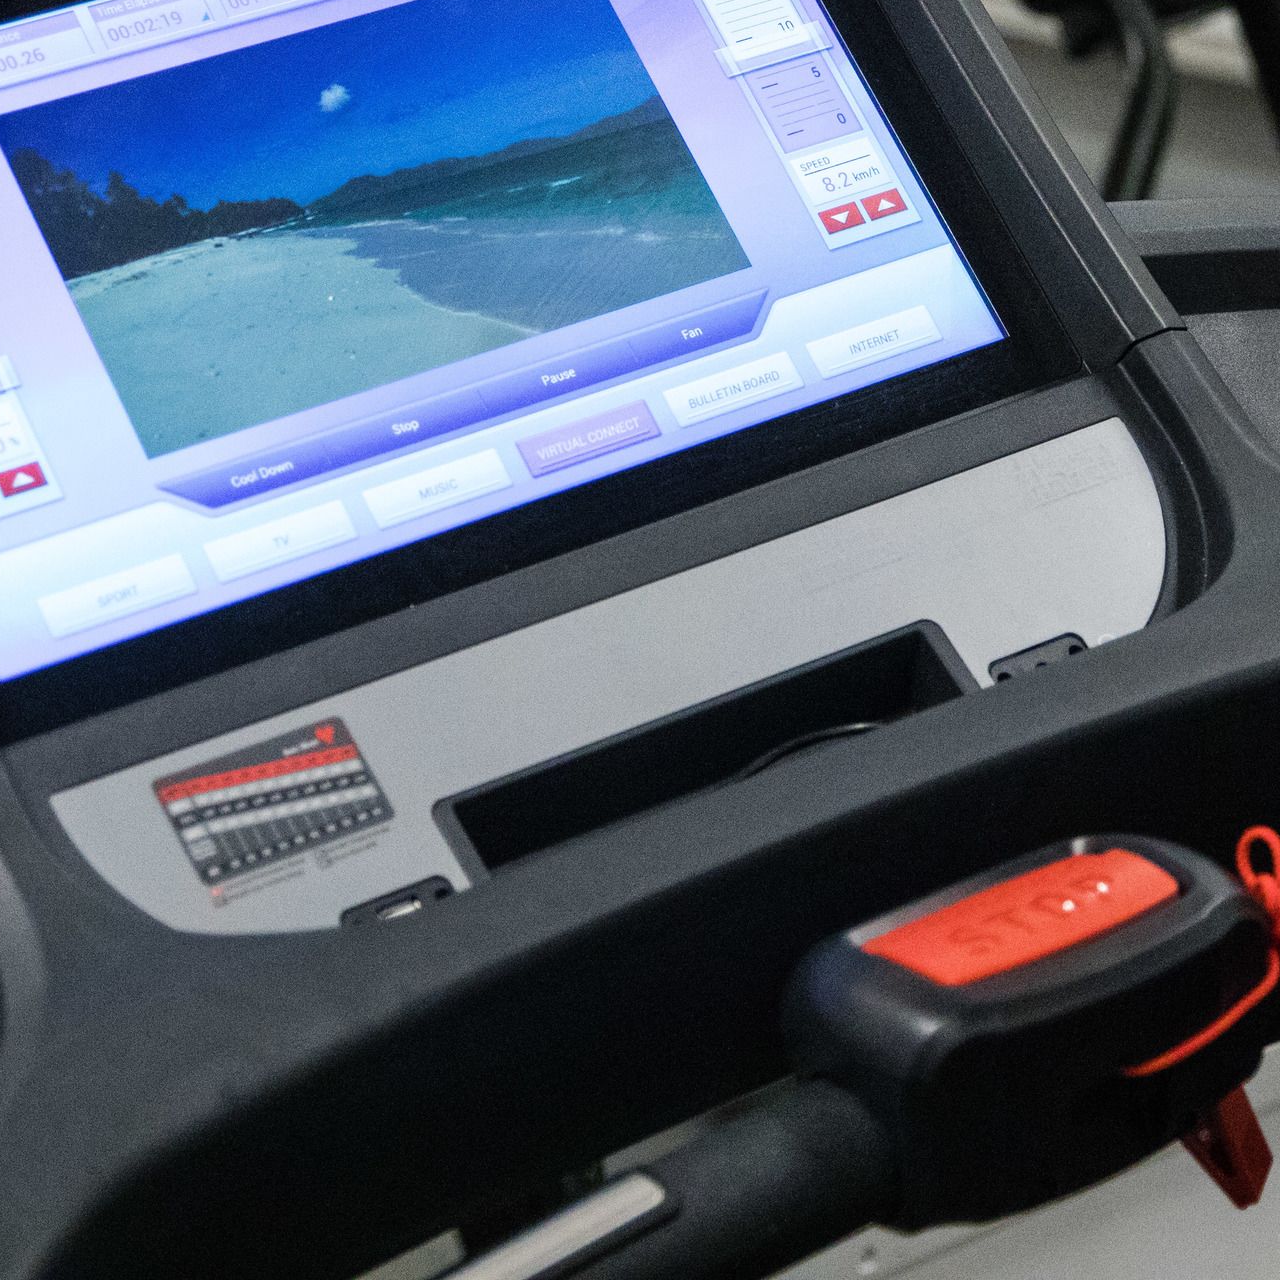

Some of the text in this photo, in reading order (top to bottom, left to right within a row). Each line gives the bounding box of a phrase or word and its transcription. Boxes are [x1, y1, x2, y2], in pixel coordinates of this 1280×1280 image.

[97, 3, 124, 18] Time
[107, 10, 183, 42] 00:02:19
[777, 20, 796, 35] 10
[811, 66, 821, 78] 5
[836, 112, 847, 125] 0
[800, 156, 831, 172] SPEED
[822, 166, 880, 193] 8.2 km/h
[681, 325, 704, 341] Fan
[848, 329, 901, 356] INTERNET
[541, 366, 577, 387] Pause
[688, 370, 780, 411] BULLETIN BOARD
[391, 419, 420, 437] Stop
[536, 416, 641, 462] VIRTUAL CONNECT
[230, 459, 295, 489] Cool Down
[417, 477, 459, 501] MUSIC
[272, 534, 291, 549] TV
[96, 584, 139, 609] SPORT
